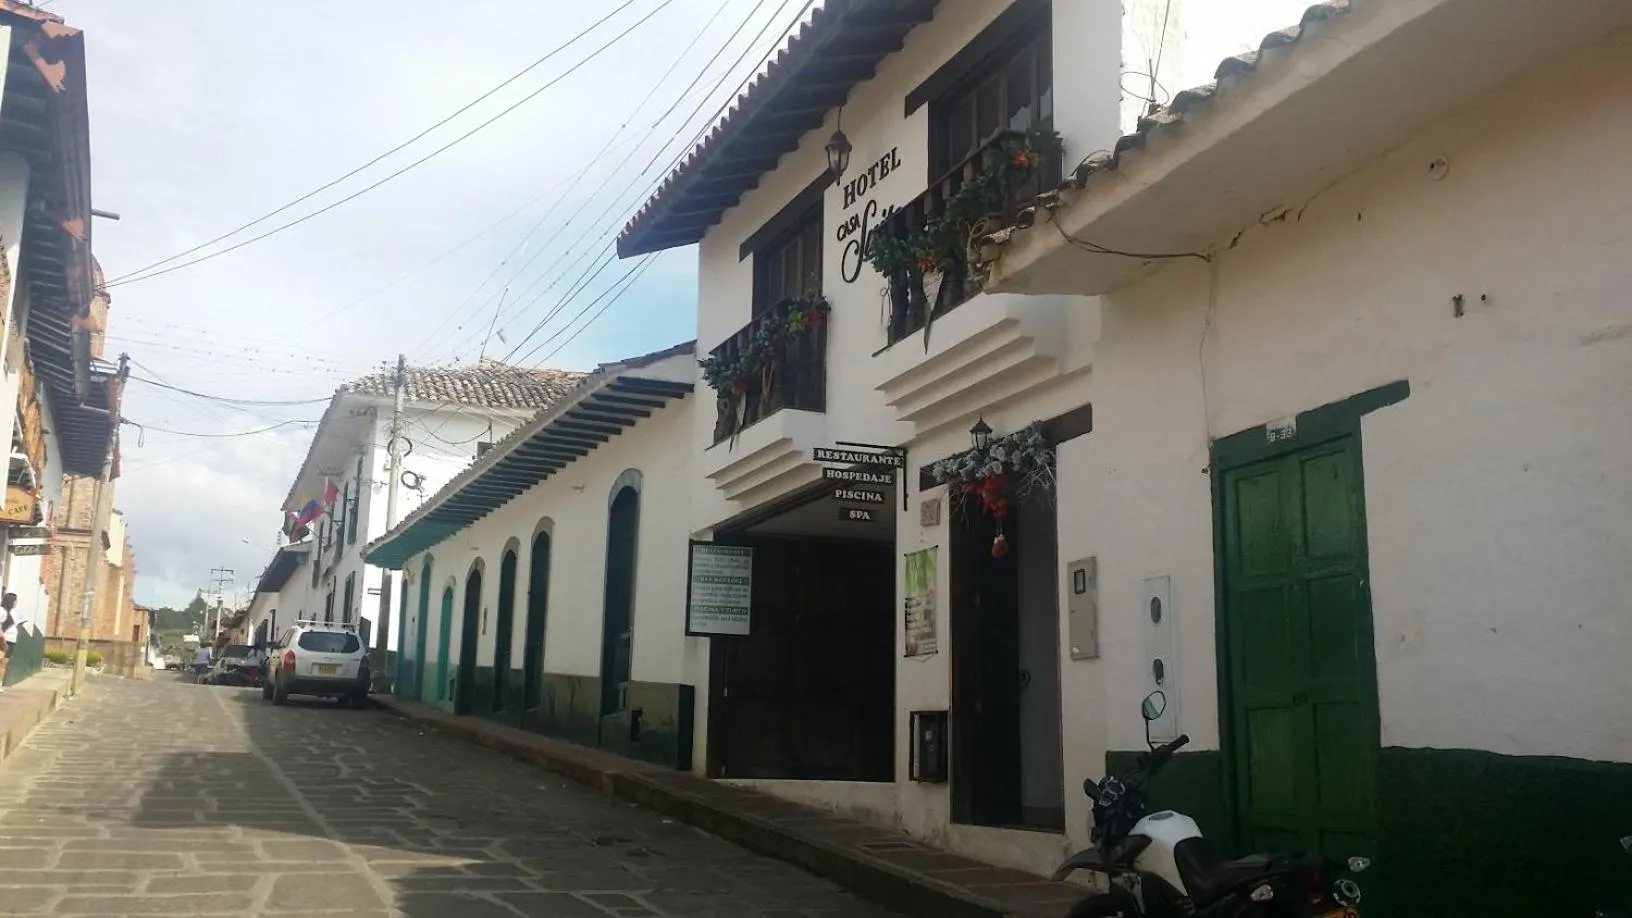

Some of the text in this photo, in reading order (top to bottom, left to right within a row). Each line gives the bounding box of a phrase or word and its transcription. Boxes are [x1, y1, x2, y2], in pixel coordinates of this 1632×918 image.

[843, 147, 901, 210] HOTEL
[837, 213, 861, 241] CASA
[817, 450, 901, 466] RESTAURANTE
[826, 470, 892, 483] HOSPEDAJE
[835, 489, 882, 501] PISCINA
[849, 510, 870, 520] SPA
